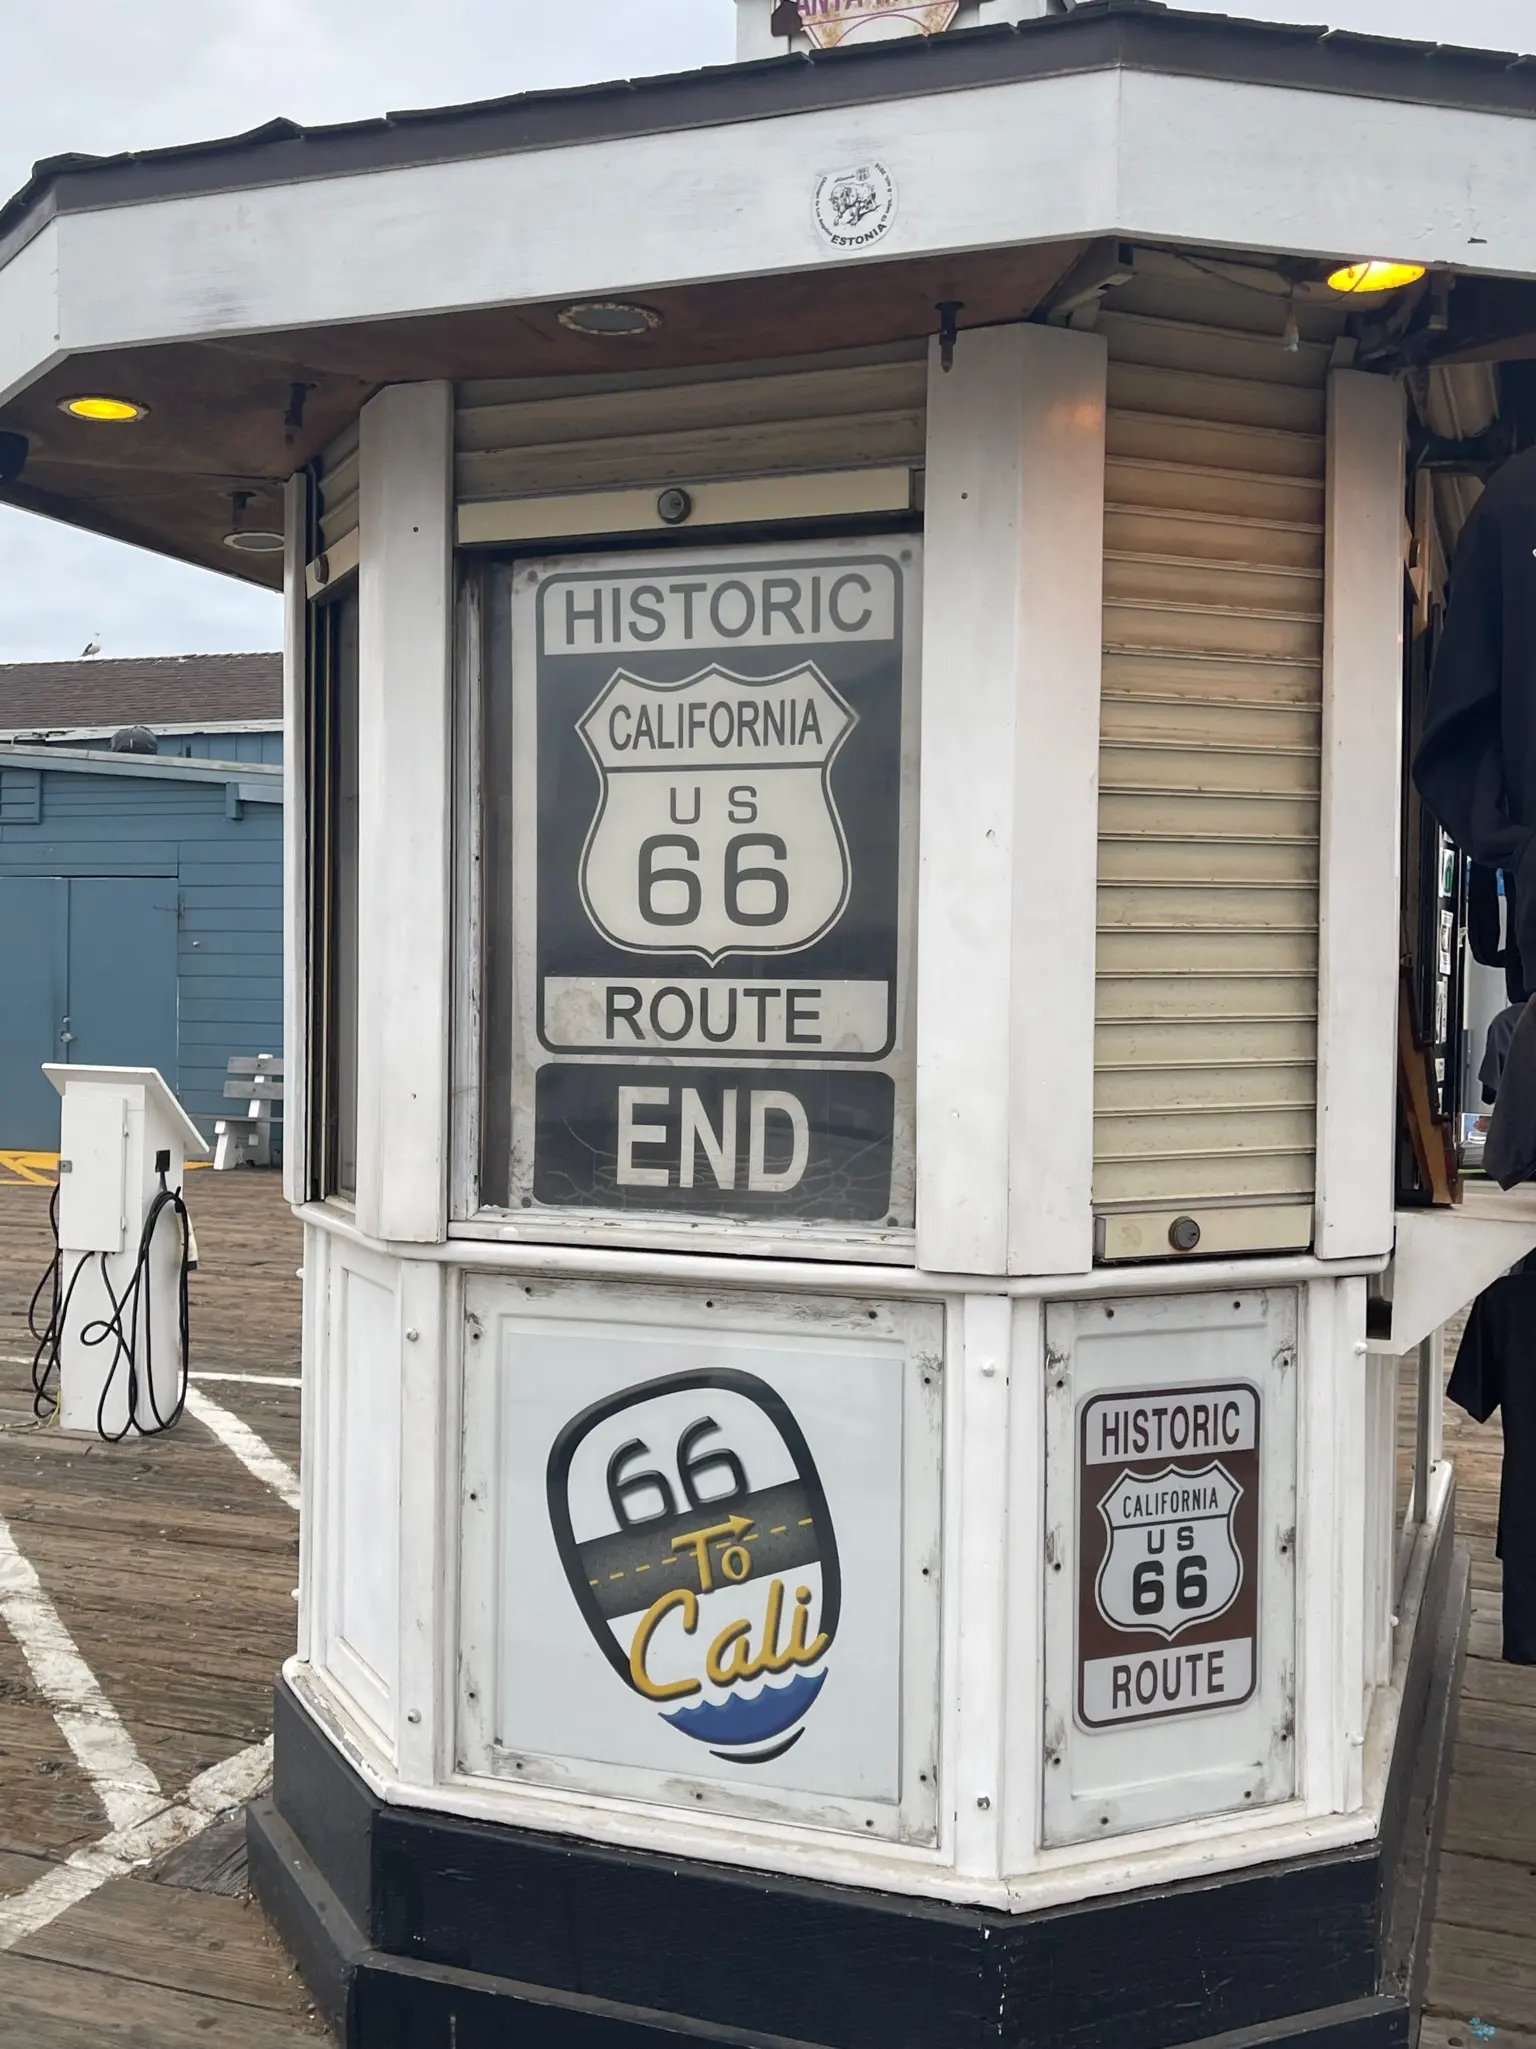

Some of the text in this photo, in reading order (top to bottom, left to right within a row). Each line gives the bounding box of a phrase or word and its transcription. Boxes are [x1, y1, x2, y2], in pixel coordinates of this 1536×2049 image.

[830, 223, 888, 246] ESTONIA
[565, 573, 872, 645] HISTORIC
[608, 698, 823, 751] CALIFORNIA
[637, 832, 790, 927] 66
[605, 986, 823, 1044] ROUTE
[616, 1085, 810, 1193] END
[1101, 1400, 1240, 1457] HISTORIC
[606, 1415, 751, 1532] 66
[1122, 1486, 1219, 1519] CALIFORNIA
[670, 1514, 754, 1593] To
[1132, 1554, 1208, 1616] 66
[629, 1578, 829, 1702] Cali
[1112, 1649, 1225, 1710] ROUTE
